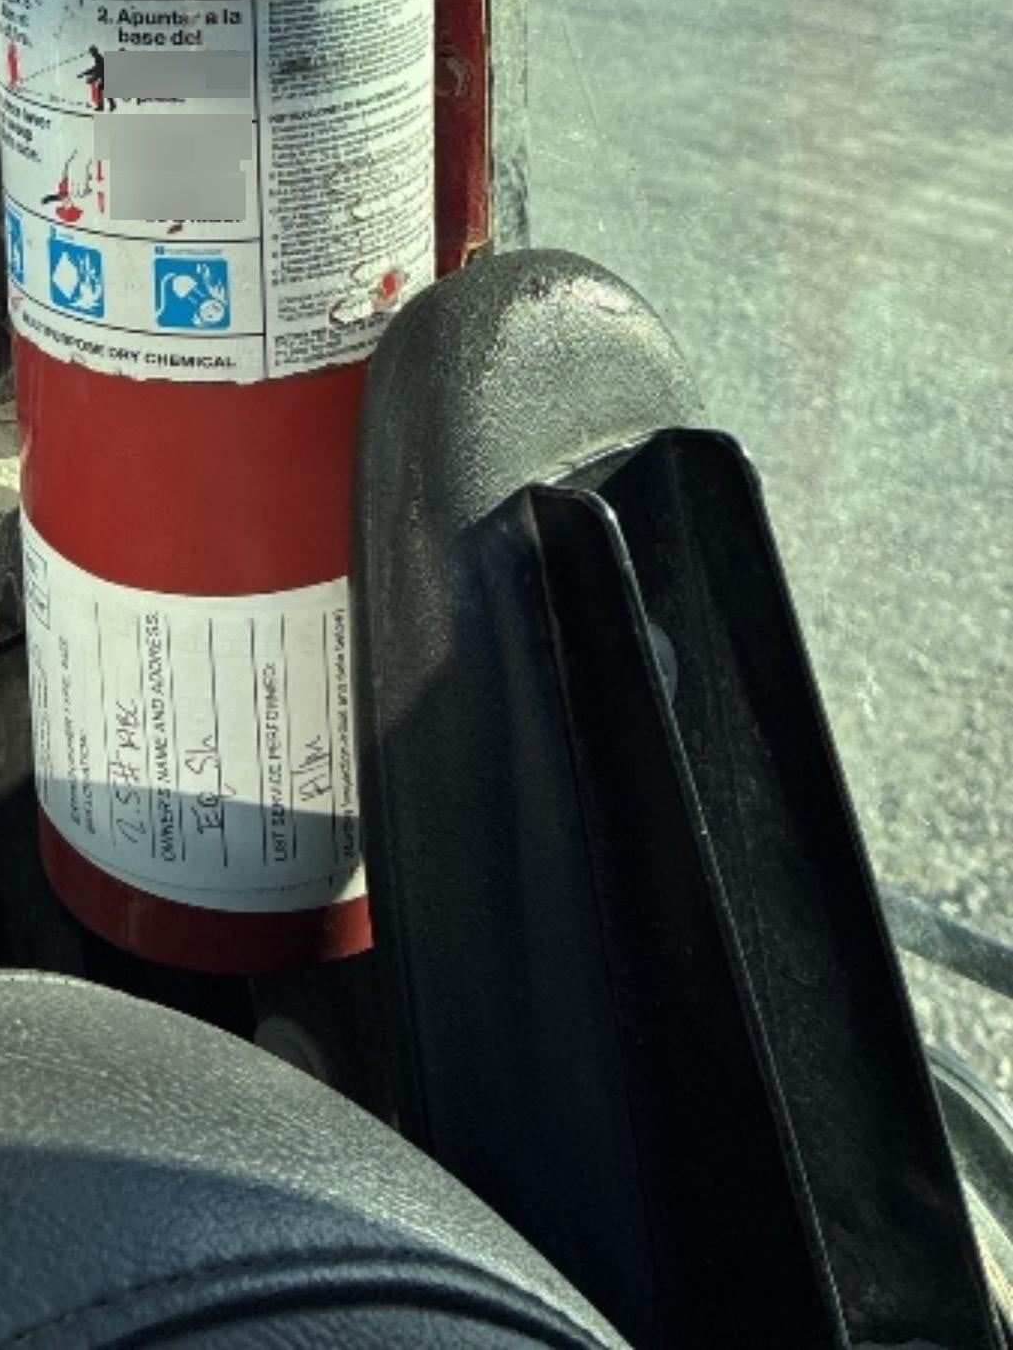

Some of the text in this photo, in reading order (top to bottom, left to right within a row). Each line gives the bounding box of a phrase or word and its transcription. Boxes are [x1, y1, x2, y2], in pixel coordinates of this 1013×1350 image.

[97, 5, 243, 28] 2. Apuntar a la
[117, 26, 203, 46] base del
[108, 346, 141, 363] DRY
[145, 353, 236, 370] CHEMICAL
[151, 699, 166, 734] AND
[154, 738, 171, 783] NAME
